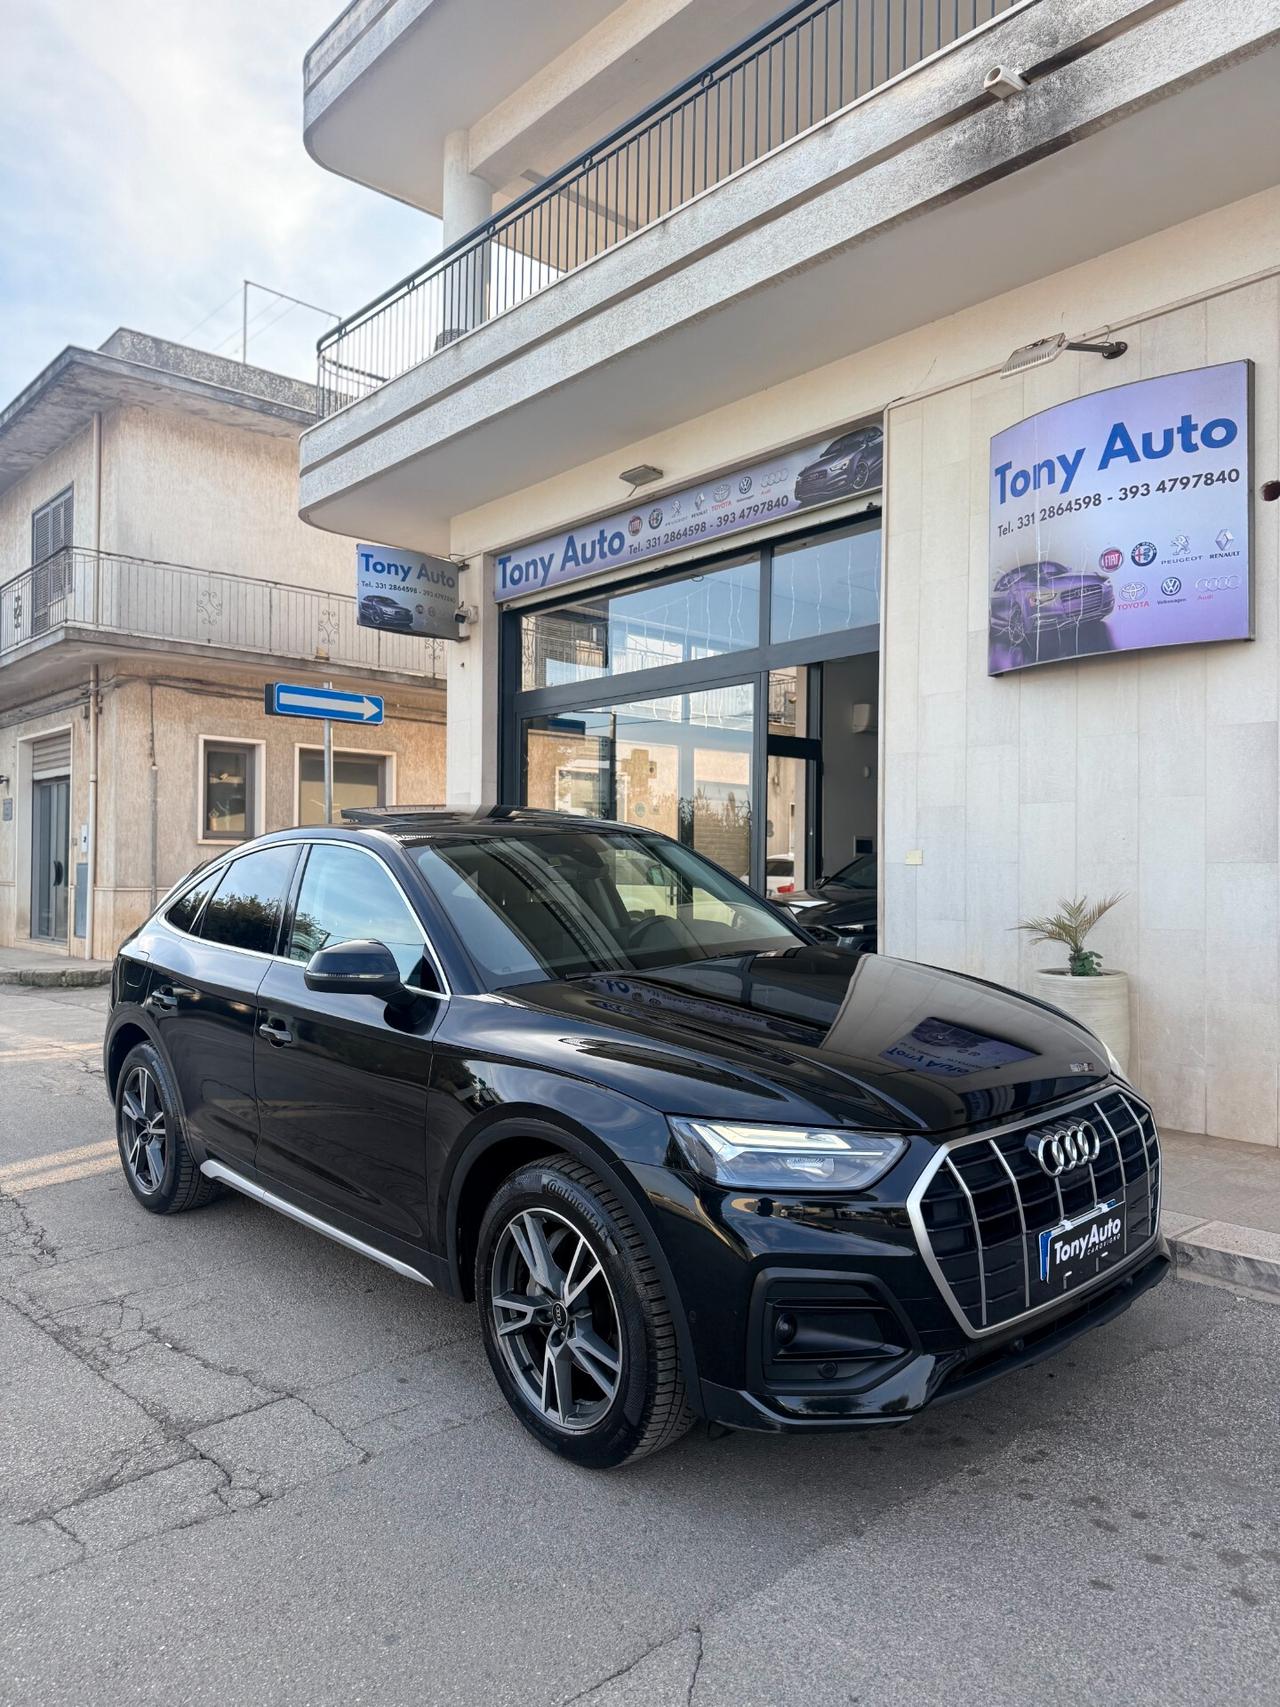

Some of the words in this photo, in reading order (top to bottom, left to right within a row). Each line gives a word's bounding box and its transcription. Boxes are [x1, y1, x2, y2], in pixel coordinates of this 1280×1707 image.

[994, 447, 1086, 505] Tony
[1097, 414, 1238, 471] Auto
[998, 521, 1014, 537] Tel.
[1017, 512, 1035, 529] 331
[1039, 493, 1102, 522] 2864598
[1118, 483, 1151, 502] 393
[1155, 468, 1240, 494] 4797840
[628, 543, 644, 555] Tel.
[646, 536, 660, 549] 331
[663, 521, 707, 544] 2864598
[716, 512, 736, 528] 393
[739, 494, 789, 520] 4797840
[498, 552, 555, 589] Tony
[560, 528, 626, 572] Auto
[1103, 553, 1120, 567] FIAT
[1160, 555, 1204, 565] PEUGEOT
[1209, 551, 1240, 560] RENAULT
[360, 553, 412, 582] Tony
[416, 562, 456, 588] Auto
[375, 582, 387, 590] 331
[389, 584, 417, 594] 2864598
[1117, 600, 1150, 611] TOYOTA
